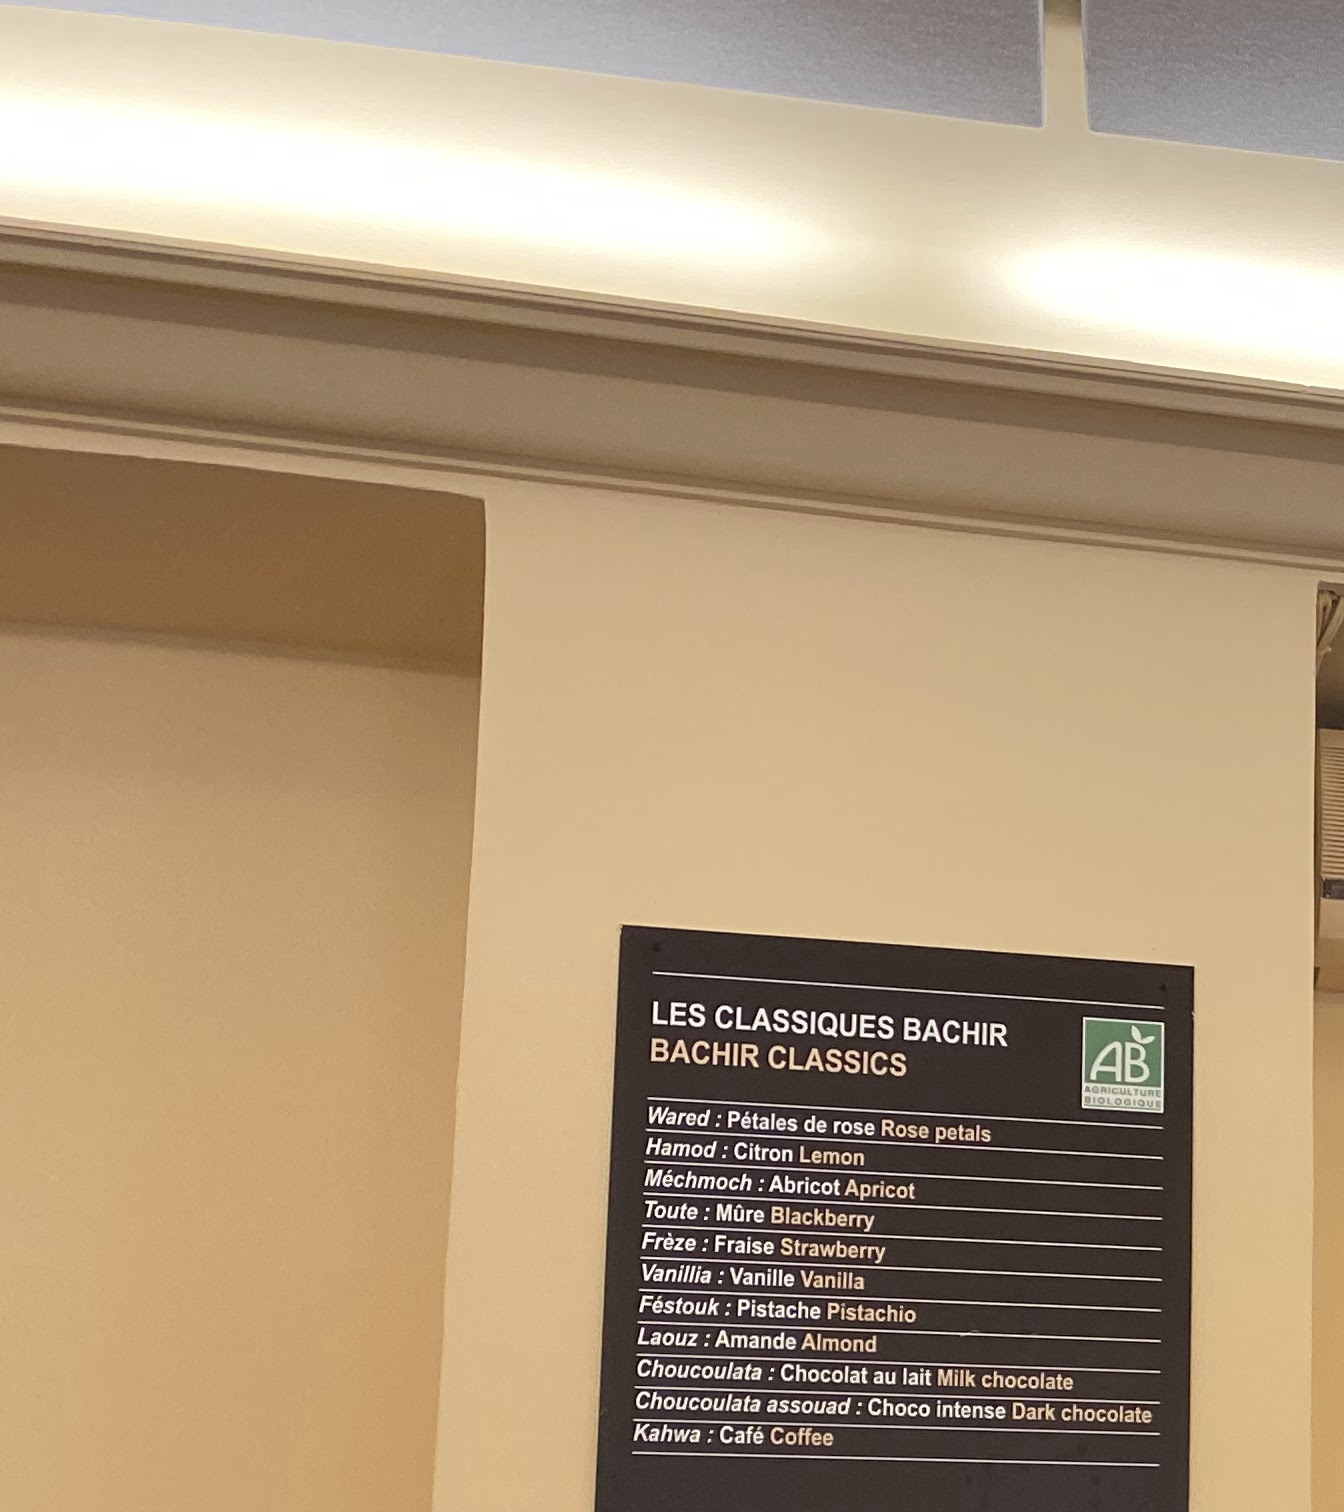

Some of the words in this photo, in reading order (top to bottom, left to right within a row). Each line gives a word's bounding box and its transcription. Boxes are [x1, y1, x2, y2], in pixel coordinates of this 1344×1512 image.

[652, 1000, 707, 1028] LES
[714, 1004, 895, 1040] CLASSIQUES
[902, 1016, 1009, 1048] BACHIR
[650, 1037, 760, 1069] BACHIR
[767, 1044, 907, 1077] CLASSICS
[1089, 1040, 1151, 1083] AB
[1083, 1085, 1162, 1098] AGRICULTURE
[1083, 1095, 1162, 1108] BIOLOGIQUE
[648, 1105, 712, 1127] Wared
[727, 1110, 799, 1133] Pétales
[803, 1114, 828, 1134] de
[832, 1120, 876, 1137] rose
[880, 1118, 930, 1140] Rose
[934, 1124, 992, 1144] petals
[645, 1136, 719, 1159] Hamod
[733, 1141, 794, 1163] Citron
[799, 1145, 865, 1167] Lemon
[643, 1168, 753, 1192] Méchmoch
[768, 1174, 841, 1197] Abricot
[843, 1178, 916, 1202] Apricot
[644, 1199, 699, 1221] Toute
[715, 1202, 766, 1224] Mûre
[770, 1205, 876, 1233] Blackberry
[641, 1231, 697, 1252] Frèze
[714, 1234, 775, 1256] Fraise
[779, 1237, 887, 1265] Strawberry
[641, 1262, 713, 1285] Vanillia
[729, 1266, 796, 1288] Vanille
[799, 1269, 865, 1291] Vanilla
[638, 1294, 721, 1316] Féstouk
[736, 1298, 822, 1320] Pistache
[826, 1301, 917, 1324] Pistachio
[636, 1326, 699, 1348] Laouz
[714, 1329, 798, 1351] Amande
[800, 1332, 878, 1353] Almond
[636, 1358, 763, 1381] Choucoulata
[780, 1363, 869, 1385] Chocolat
[872, 1370, 897, 1386] au
[902, 1367, 933, 1387] lait
[937, 1368, 977, 1388] Milk
[981, 1370, 1074, 1391] chocolate
[635, 1390, 762, 1413] Choucoulata
[766, 1396, 852, 1416] assouad
[867, 1397, 931, 1418] Choco
[936, 1399, 1007, 1420] intense
[1011, 1401, 1057, 1421] Dark
[1060, 1403, 1153, 1424] chocolate
[632, 1422, 702, 1444] Kahwa
[719, 1424, 765, 1445] Café
[769, 1426, 835, 1447] Coffee
